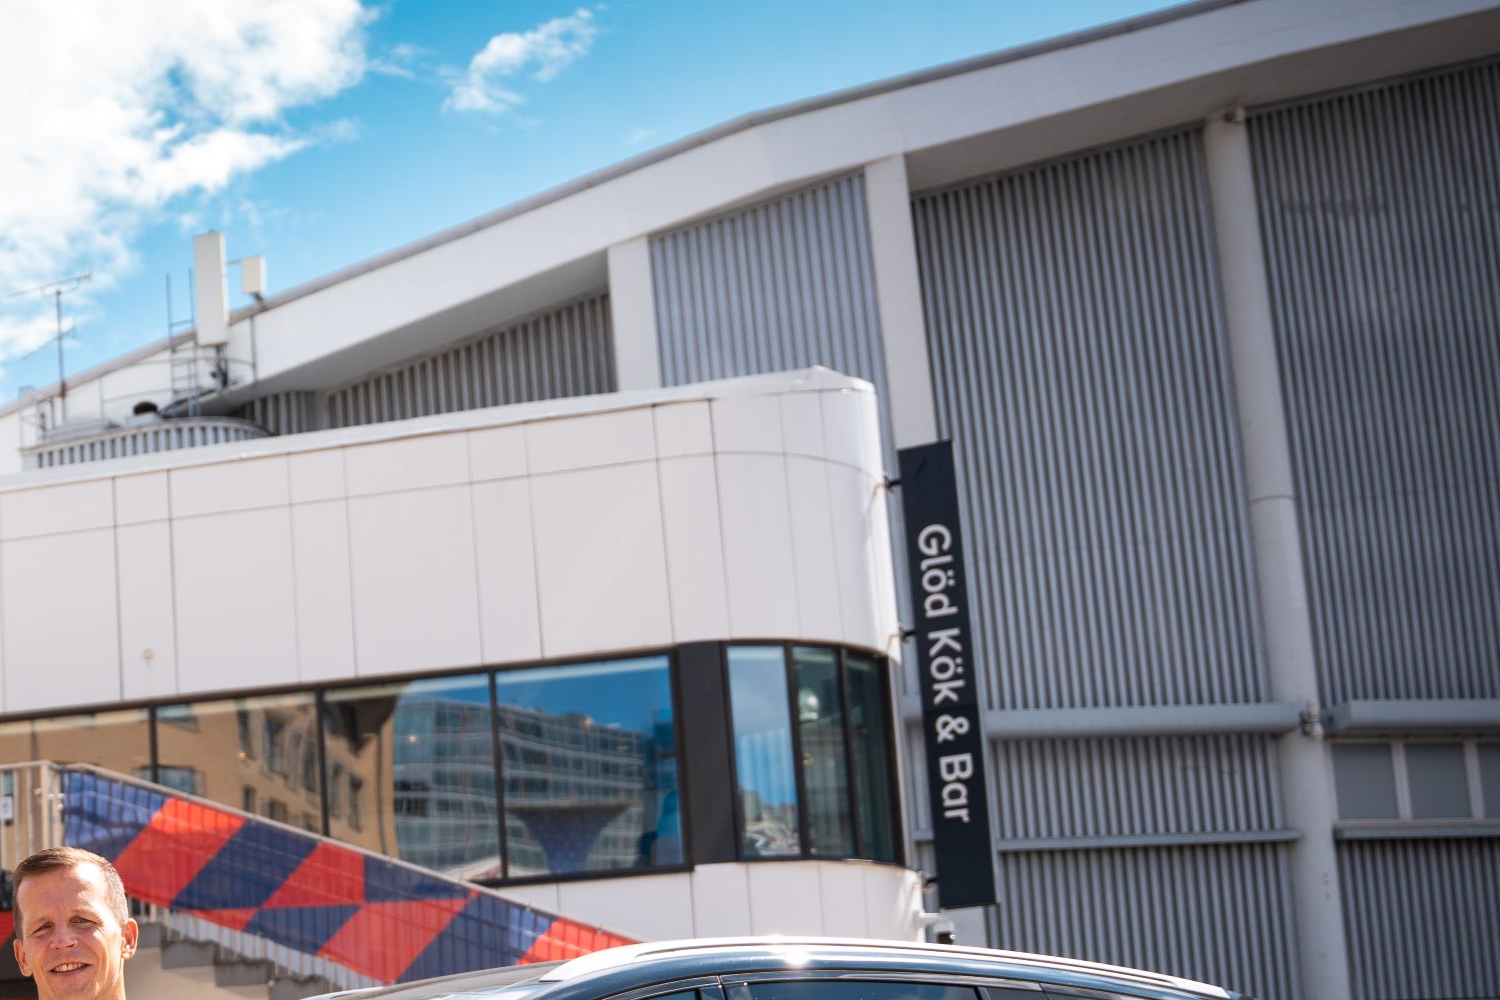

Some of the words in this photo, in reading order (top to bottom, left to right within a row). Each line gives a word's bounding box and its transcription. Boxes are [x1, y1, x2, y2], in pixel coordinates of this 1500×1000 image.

[918, 524, 958, 618] Glöd
[927, 628, 966, 705] Kök
[935, 714, 970, 743] &
[939, 753, 974, 822] Bar
